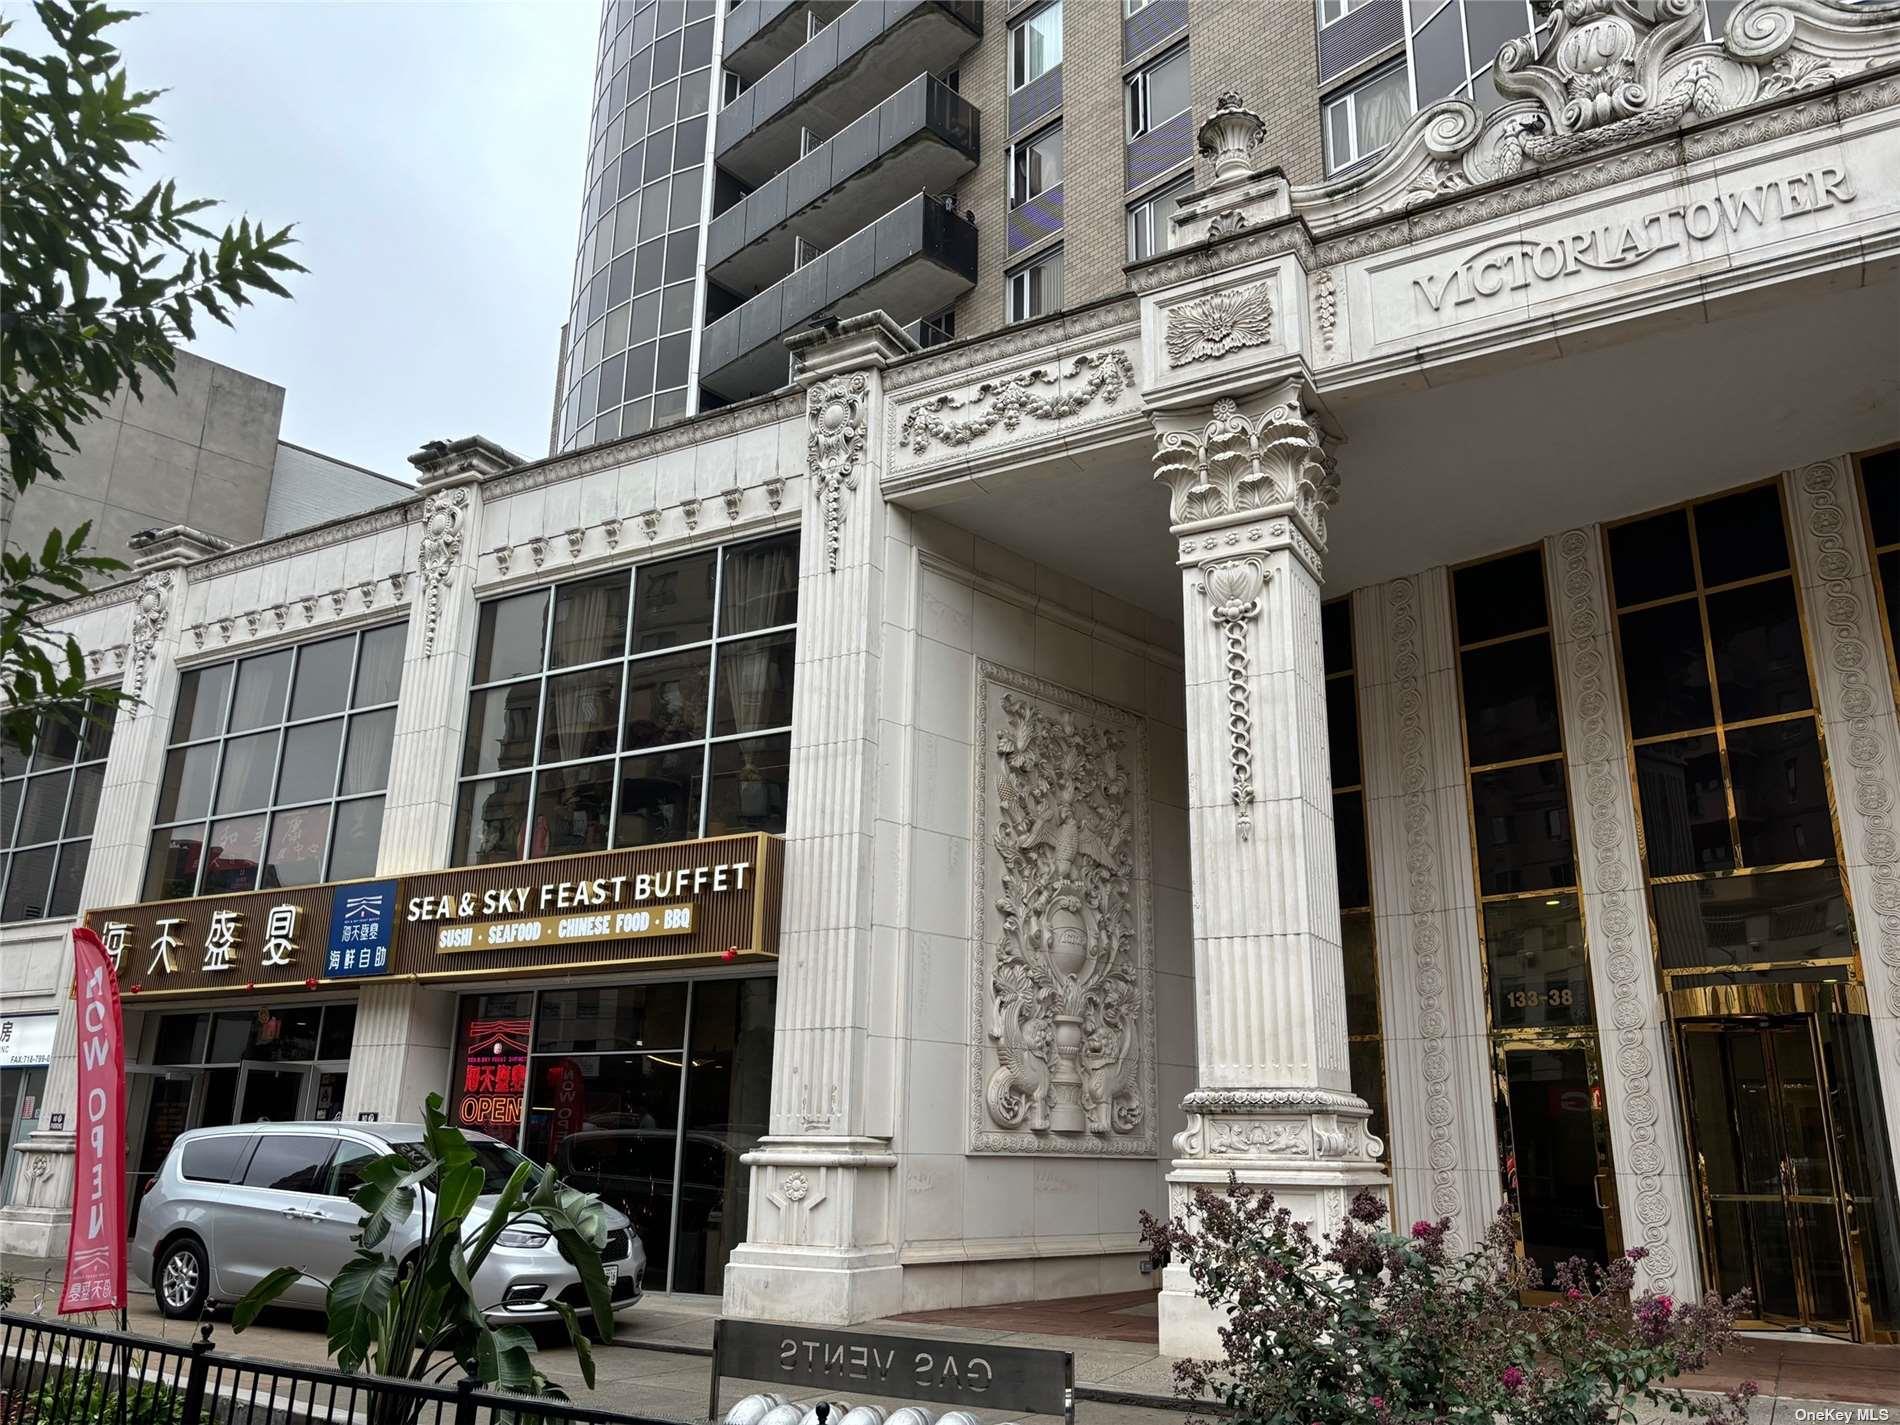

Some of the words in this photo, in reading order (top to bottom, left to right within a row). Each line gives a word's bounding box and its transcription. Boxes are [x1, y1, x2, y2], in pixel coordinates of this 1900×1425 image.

[408, 895, 451, 921] SEA
[458, 891, 475, 917] &
[483, 886, 531, 914] SKY
[540, 876, 626, 910] FEAST
[635, 862, 749, 900] BUFFET
[439, 927, 474, 948] SUSHI
[488, 921, 542, 944] SEAFOOD
[558, 915, 611, 938] CHINESE
[615, 911, 650, 934] FOOD
[664, 907, 691, 929] BBQ
[461, 1096, 524, 1123] OPEN
